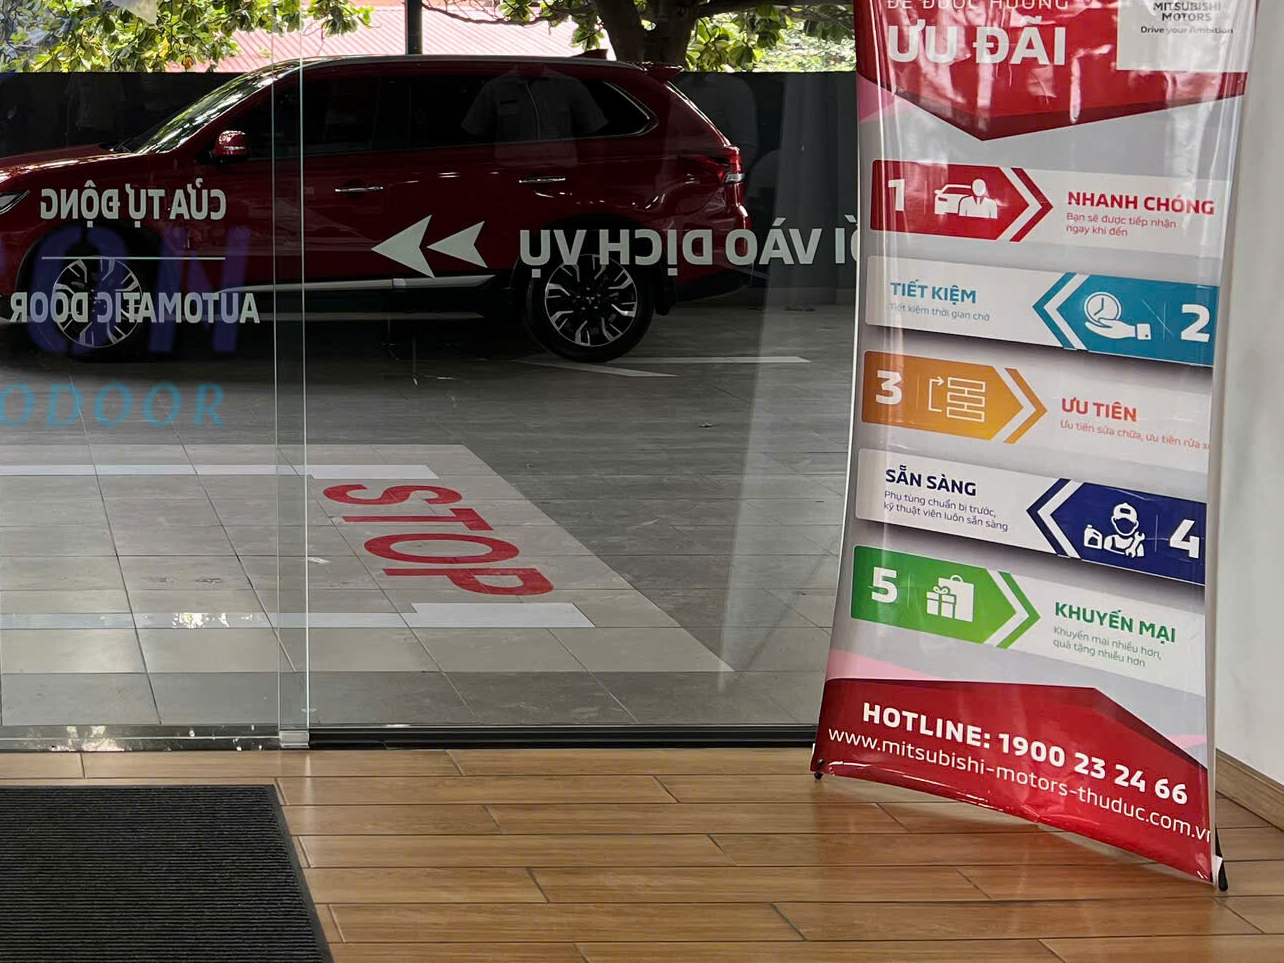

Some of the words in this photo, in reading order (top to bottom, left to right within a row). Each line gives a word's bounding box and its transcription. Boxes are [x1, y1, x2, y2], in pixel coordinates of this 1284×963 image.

[1153, 2, 1221, 11] MITSUBISHI
[1161, 12, 1213, 22] MOTORS
[888, 18, 958, 64] ƯU
[972, 15, 1066, 66] ĐÃI
[1140, 25, 1165, 34] Drive
[888, 178, 906, 212] 1
[1067, 191, 1138, 210] NHANH
[1143, 194, 1215, 215] CHÓNG
[1066, 224, 1090, 235] ngay
[1092, 224, 1107, 235] khi
[890, 279, 928, 299] TIẾT
[931, 284, 976, 305] KIỆM
[951, 309, 971, 320] gian
[1180, 304, 1211, 343] 2
[875, 370, 903, 406] 3
[1061, 397, 1089, 415] ƯU
[1092, 401, 1137, 422] TIÊN
[1076, 421, 1095, 433] tiên
[885, 464, 922, 488] SẴN
[926, 473, 976, 497] SÀNG
[923, 507, 942, 518] viên
[323, 484, 555, 596] STOP
[1169, 518, 1201, 559] 4
[871, 566, 898, 604] 5
[1055, 601, 1134, 633] KHUYẾN
[1139, 620, 1176, 645] MẠI
[1126, 655, 1146, 667] hơn
[863, 702, 991, 749] HOTLINE:
[998, 733, 1065, 767] 1900
[1073, 751, 1106, 779] 23
[1114, 764, 1146, 792] 24
[1154, 778, 1188, 805] 66
